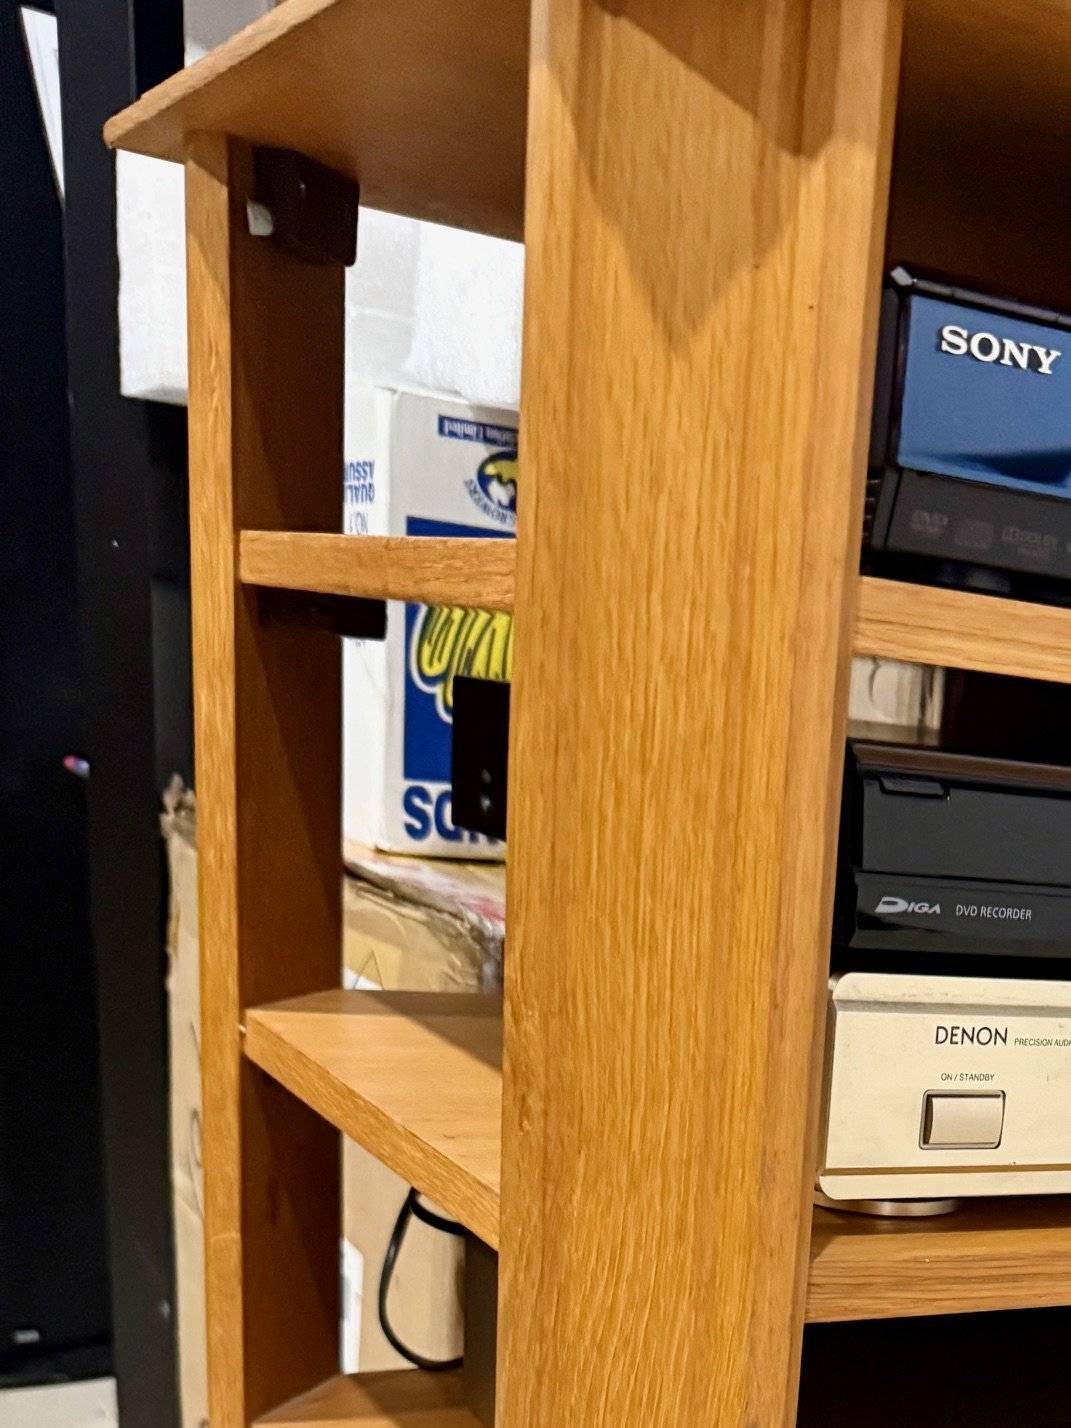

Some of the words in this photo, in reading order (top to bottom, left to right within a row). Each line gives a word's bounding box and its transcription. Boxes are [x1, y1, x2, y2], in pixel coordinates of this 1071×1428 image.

[940, 325, 1061, 375] SONY
[875, 896, 941, 914] DIGA
[956, 904, 978, 917] DVD
[980, 906, 1032, 920] RECORDER
[935, 1025, 1008, 1046] DENON
[1014, 1038, 1053, 1047] PRECISION
[941, 1073, 953, 1081] ON
[959, 1072, 995, 1082] STANDBY
